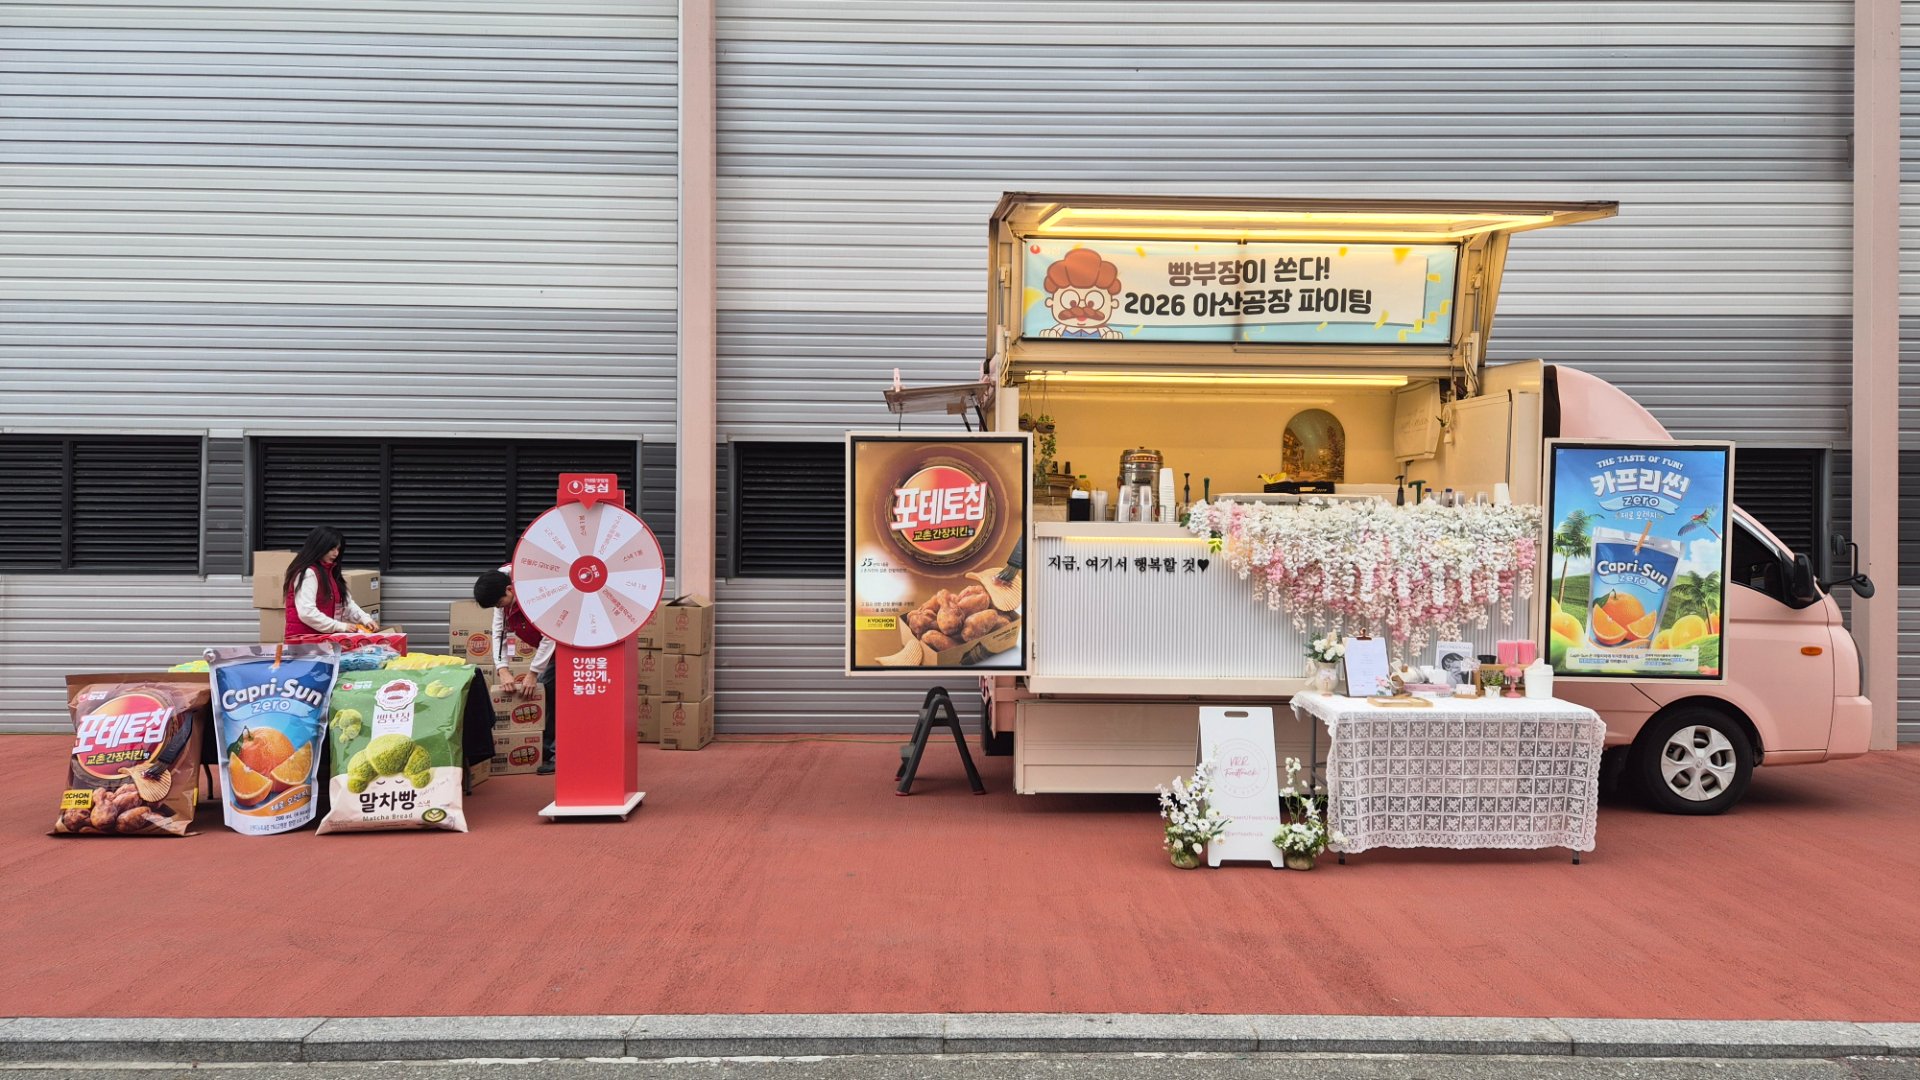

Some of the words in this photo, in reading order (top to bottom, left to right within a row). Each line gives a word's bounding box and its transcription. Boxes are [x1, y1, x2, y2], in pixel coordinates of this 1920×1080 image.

[1167, 257, 1267, 287] 빵부장이
[1273, 256, 1331, 283] 쏜다!
[1124, 292, 1186, 317] 2026
[1192, 289, 1292, 317] 아산공장
[1298, 287, 1373, 314] 파이팅
[1596, 458, 1615, 468] THE
[1617, 455, 1646, 463] TASTE
[1648, 455, 1660, 463] OF
[1662, 457, 1684, 470] FUN!
[584, 483, 609, 493] 농심
[1590, 468, 1690, 500] 카프리썬
[891, 482, 988, 531] 포테토칩
[1622, 495, 1660, 506] zero
[913, 529, 932, 542] 교촌
[1048, 555, 1081, 572] 지금,
[1086, 556, 1128, 572] 여기서
[1134, 556, 1177, 573] 행복할
[1597, 560, 1668, 586] Capri-Sun
[1618, 574, 1647, 585] zero
[572, 657, 607, 669] 인생을
[573, 670, 611, 684] 맛있게,
[222, 677, 323, 711] Capri-Sun
[572, 683, 596, 695] 농심
[251, 699, 290, 714] zero
[72, 707, 174, 754] 포테토칩
[85, 753, 107, 766] 교촌
[359, 789, 418, 813] 말차빵
